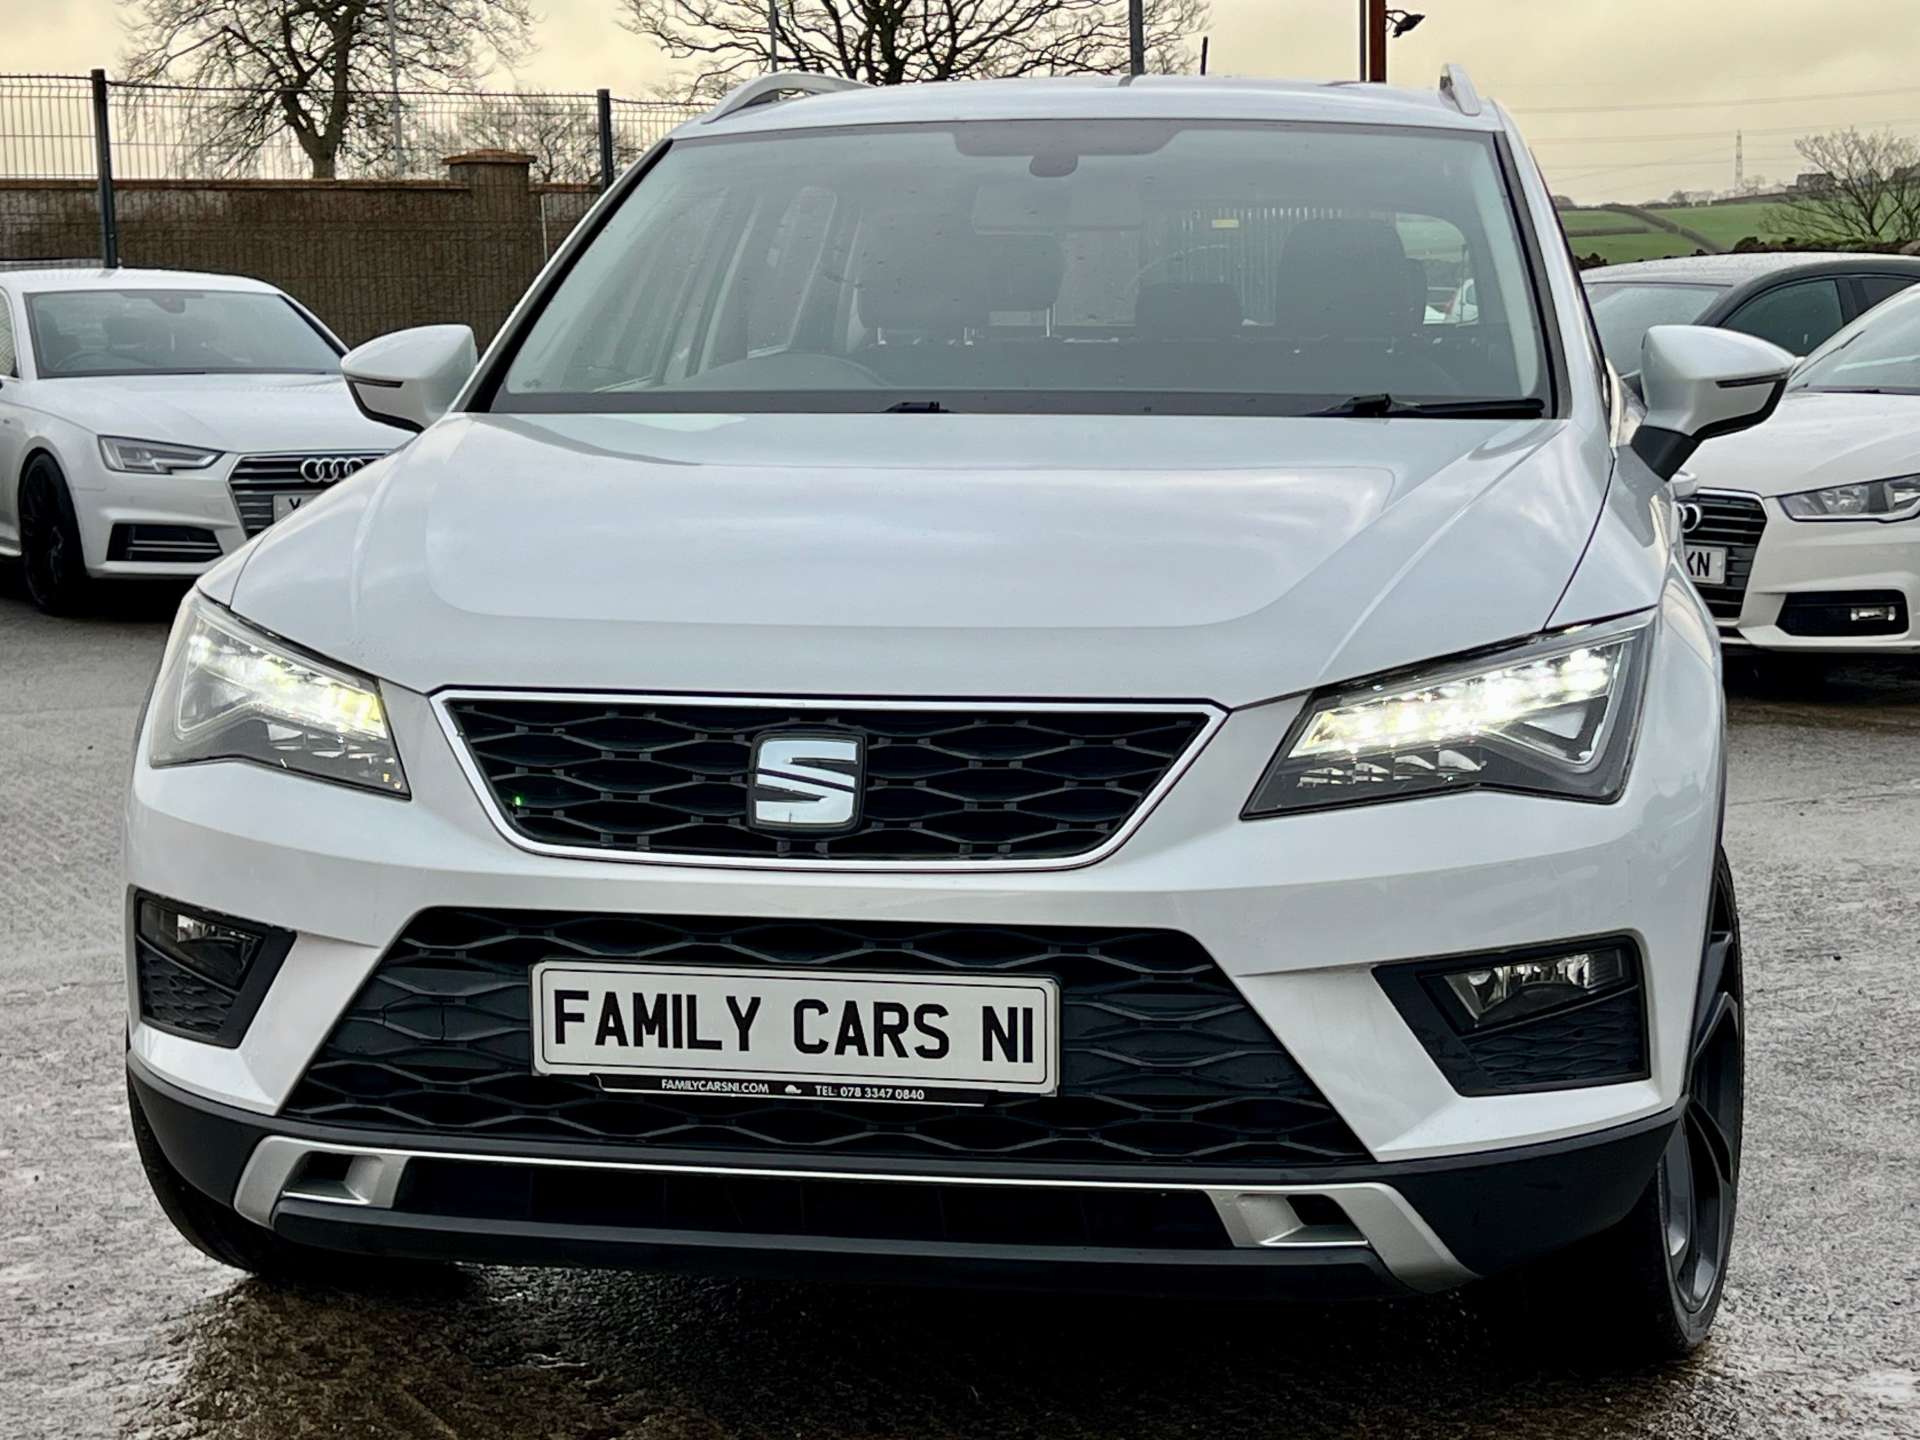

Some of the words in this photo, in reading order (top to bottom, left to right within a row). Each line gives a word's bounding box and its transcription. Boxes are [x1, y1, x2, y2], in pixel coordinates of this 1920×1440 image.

[554, 989, 761, 1051] FAMILY
[794, 999, 949, 1059] CARS
[982, 1005, 1033, 1063] NI
[661, 1079, 769, 1094] FAMILYCARSNI.COM
[840, 1086, 862, 1098] 078
[864, 1088, 893, 1099] 3347
[895, 1089, 925, 1100] 0840
